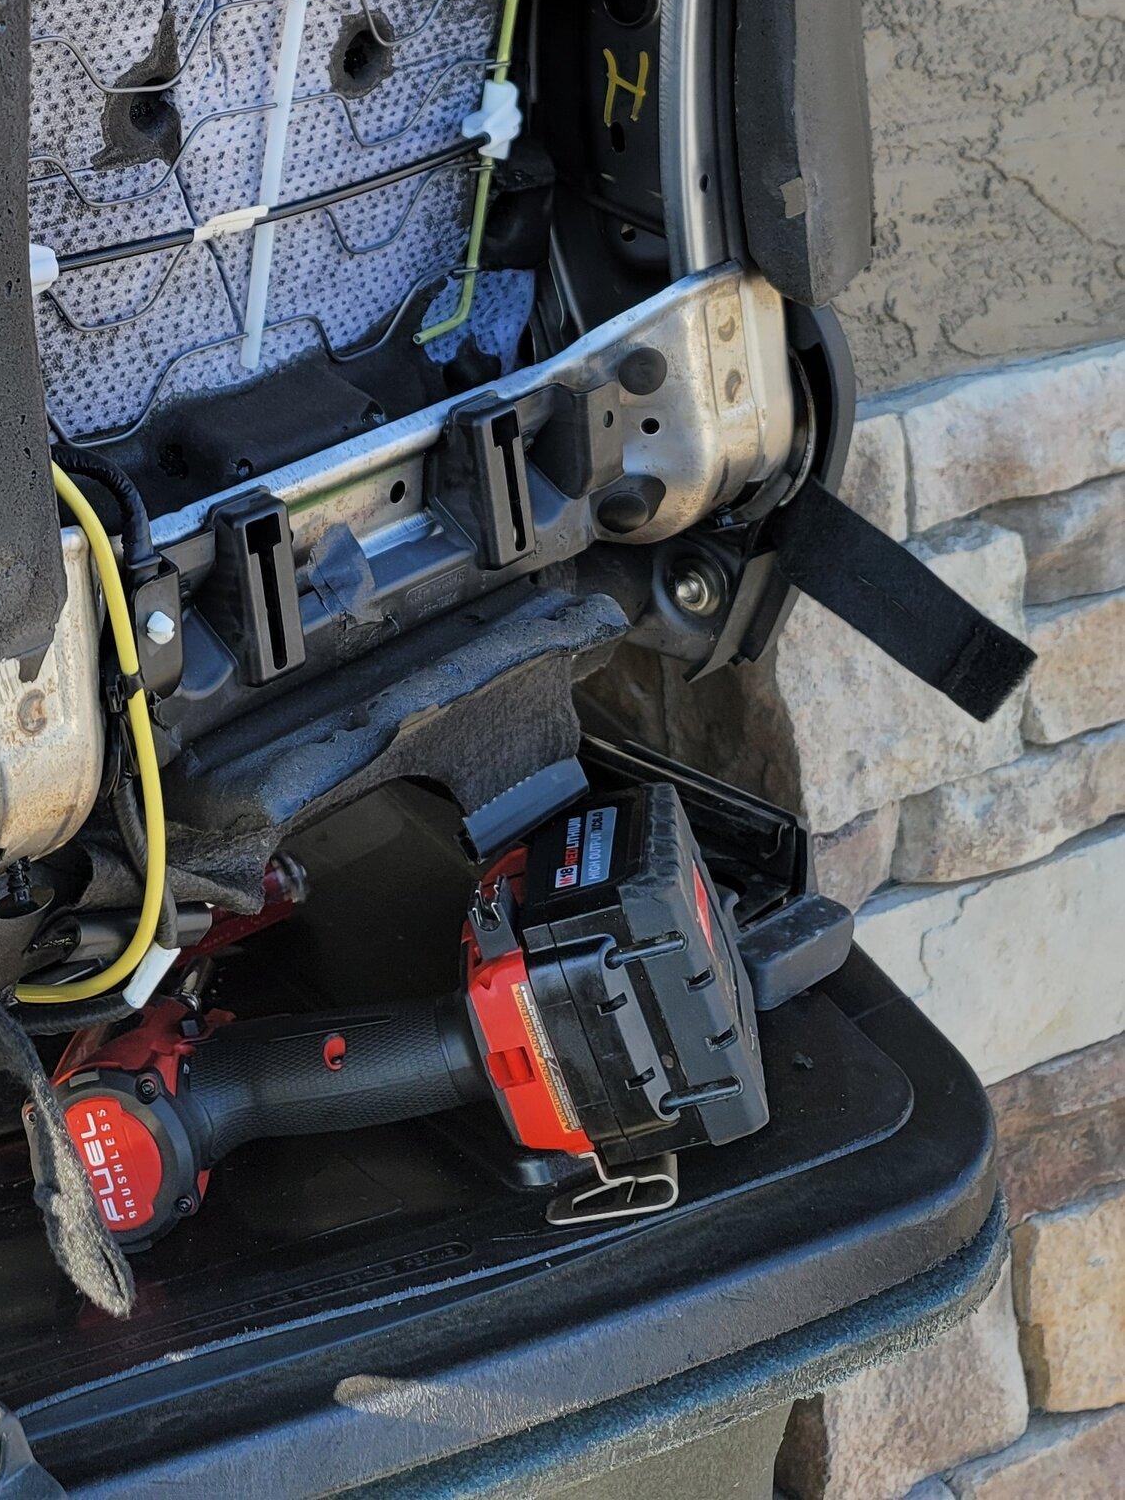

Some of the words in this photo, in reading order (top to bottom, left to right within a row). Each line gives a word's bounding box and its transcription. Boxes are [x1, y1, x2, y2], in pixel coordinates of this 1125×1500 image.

[603, 48, 649, 127] H
[559, 867, 574, 886] M18
[588, 860, 602, 880] HIGH
[589, 832, 603, 860] OUTPUT
[513, 989, 540, 1051] ADVERTENCIA
[80, 1112, 125, 1222] FUEL
[97, 1108, 138, 1219] BRUSHLESS
